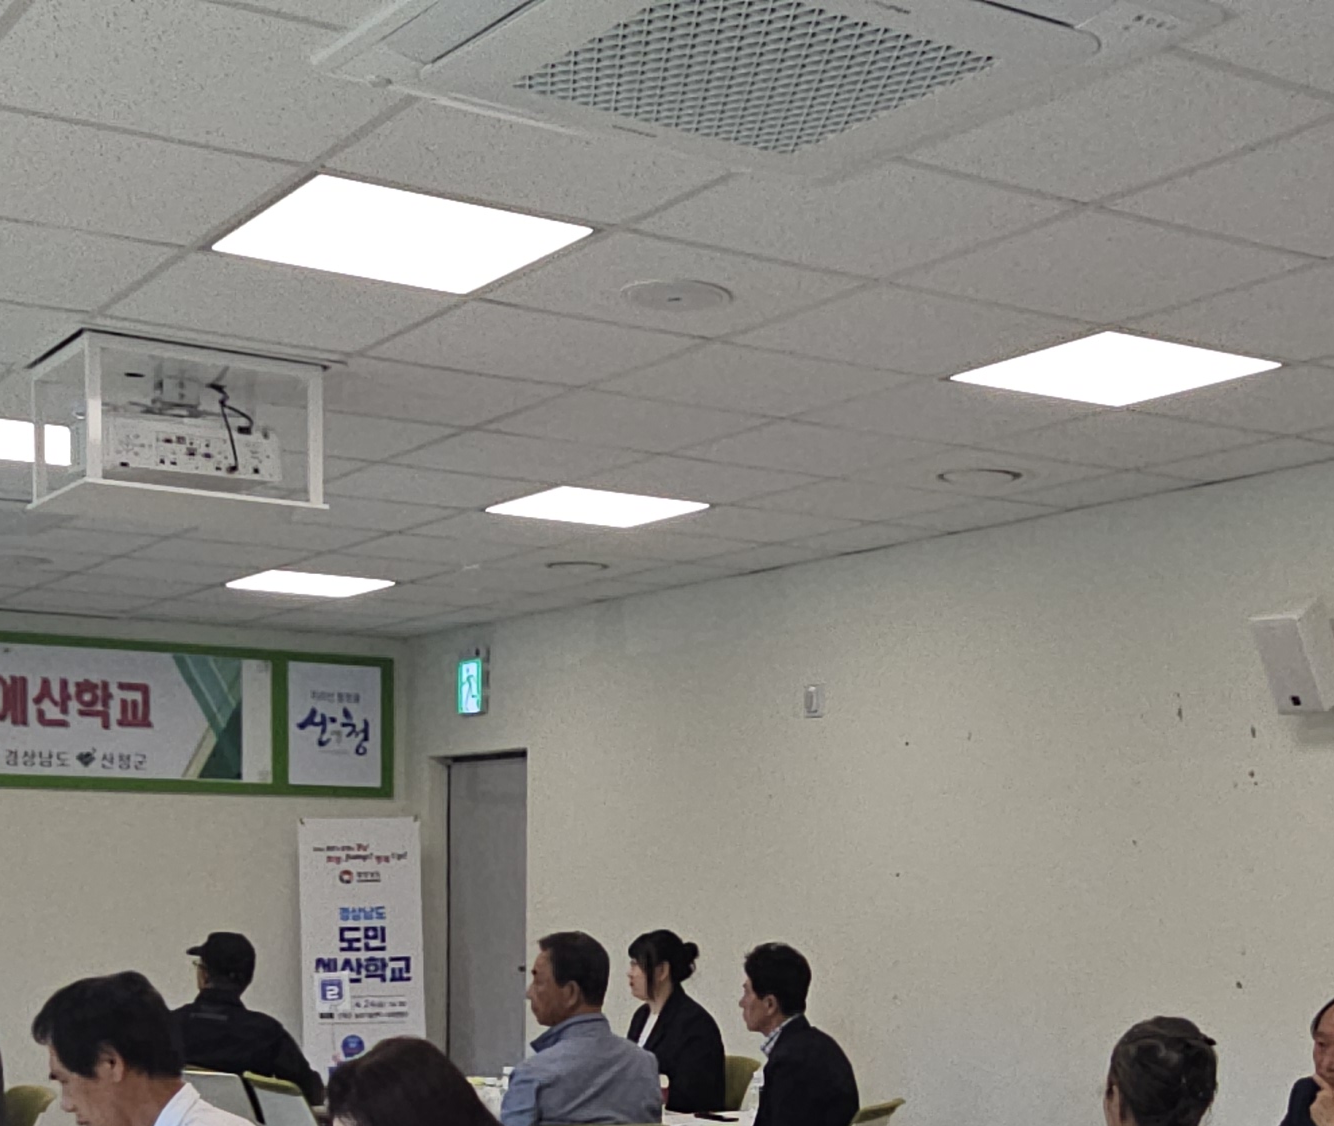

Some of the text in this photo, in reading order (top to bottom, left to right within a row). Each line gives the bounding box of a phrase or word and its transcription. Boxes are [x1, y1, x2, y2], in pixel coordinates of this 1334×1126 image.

[5, 749, 70, 767] 경상남도
[339, 926, 387, 952] 도민
[325, 985, 340, 1000] 2
